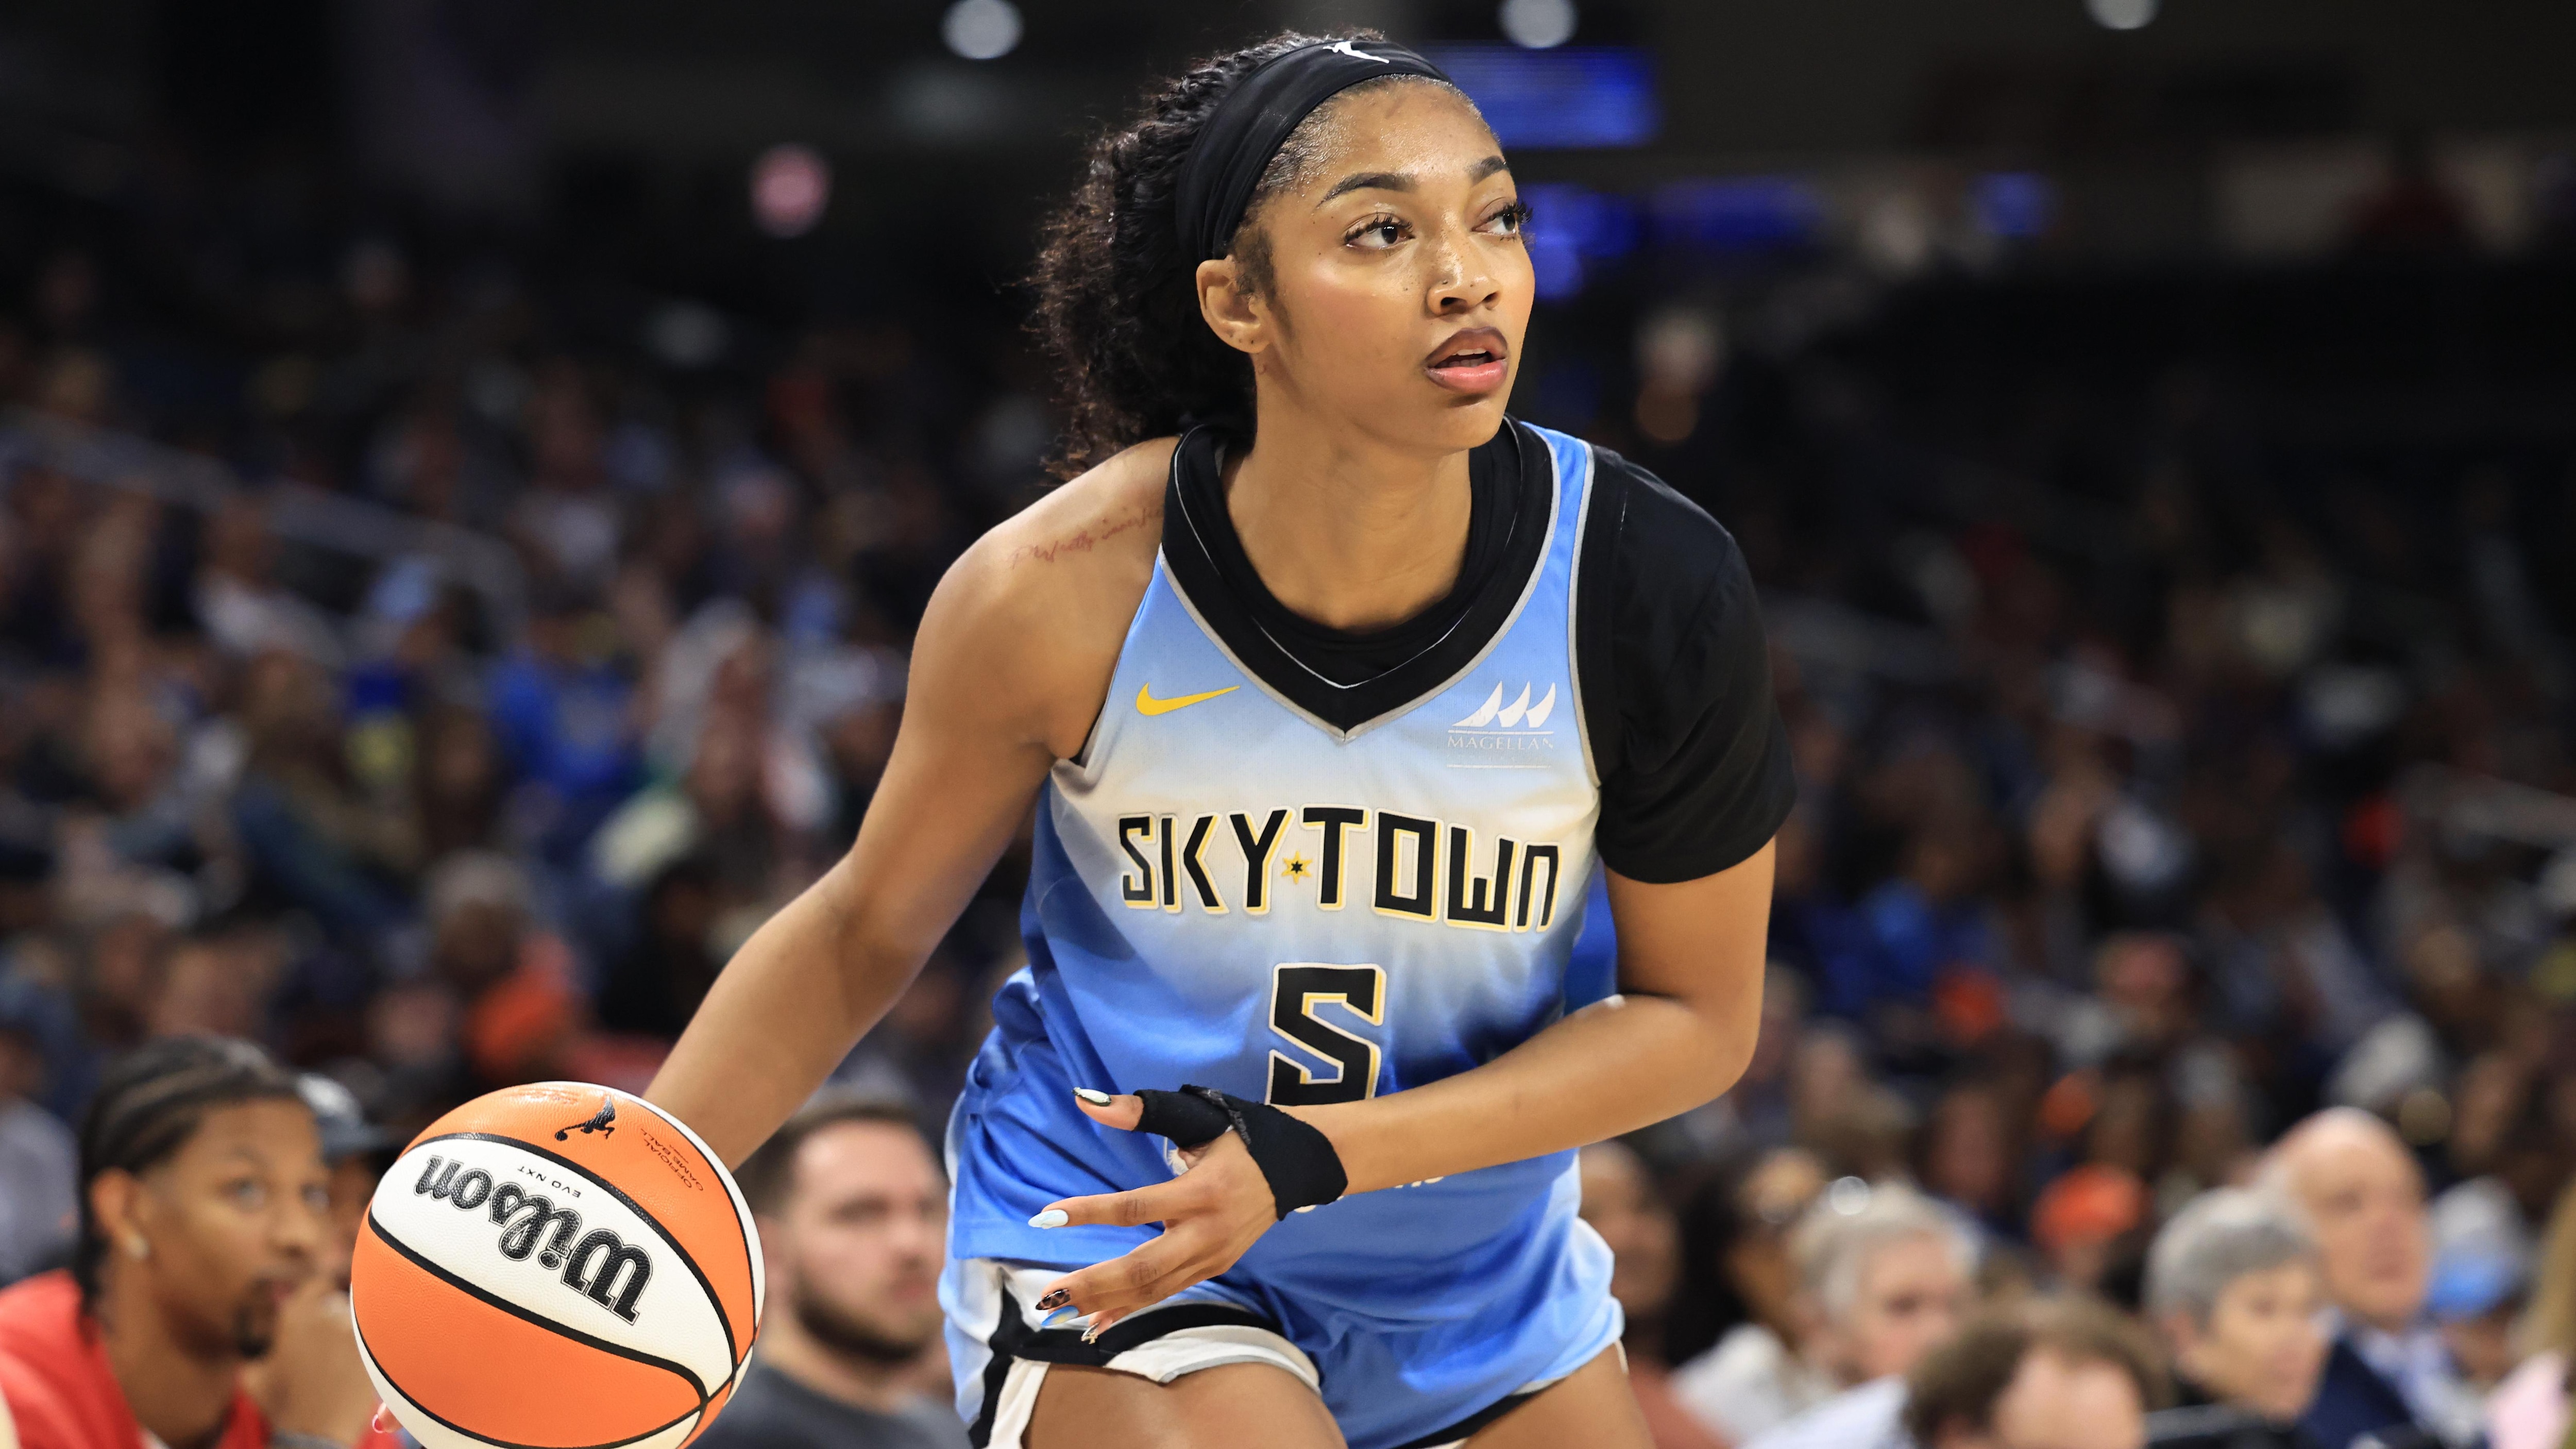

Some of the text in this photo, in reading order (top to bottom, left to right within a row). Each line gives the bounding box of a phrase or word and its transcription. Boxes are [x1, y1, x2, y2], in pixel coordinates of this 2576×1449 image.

[1448, 736, 1554, 750] MAGELLAN
[640, 1127, 671, 1155] BALL
[643, 1138, 692, 1188] OFFICIAL
[672, 1156, 704, 1191] GAME
[517, 1166, 581, 1198] EVO NXT
[413, 1154, 653, 1326] Wilson
